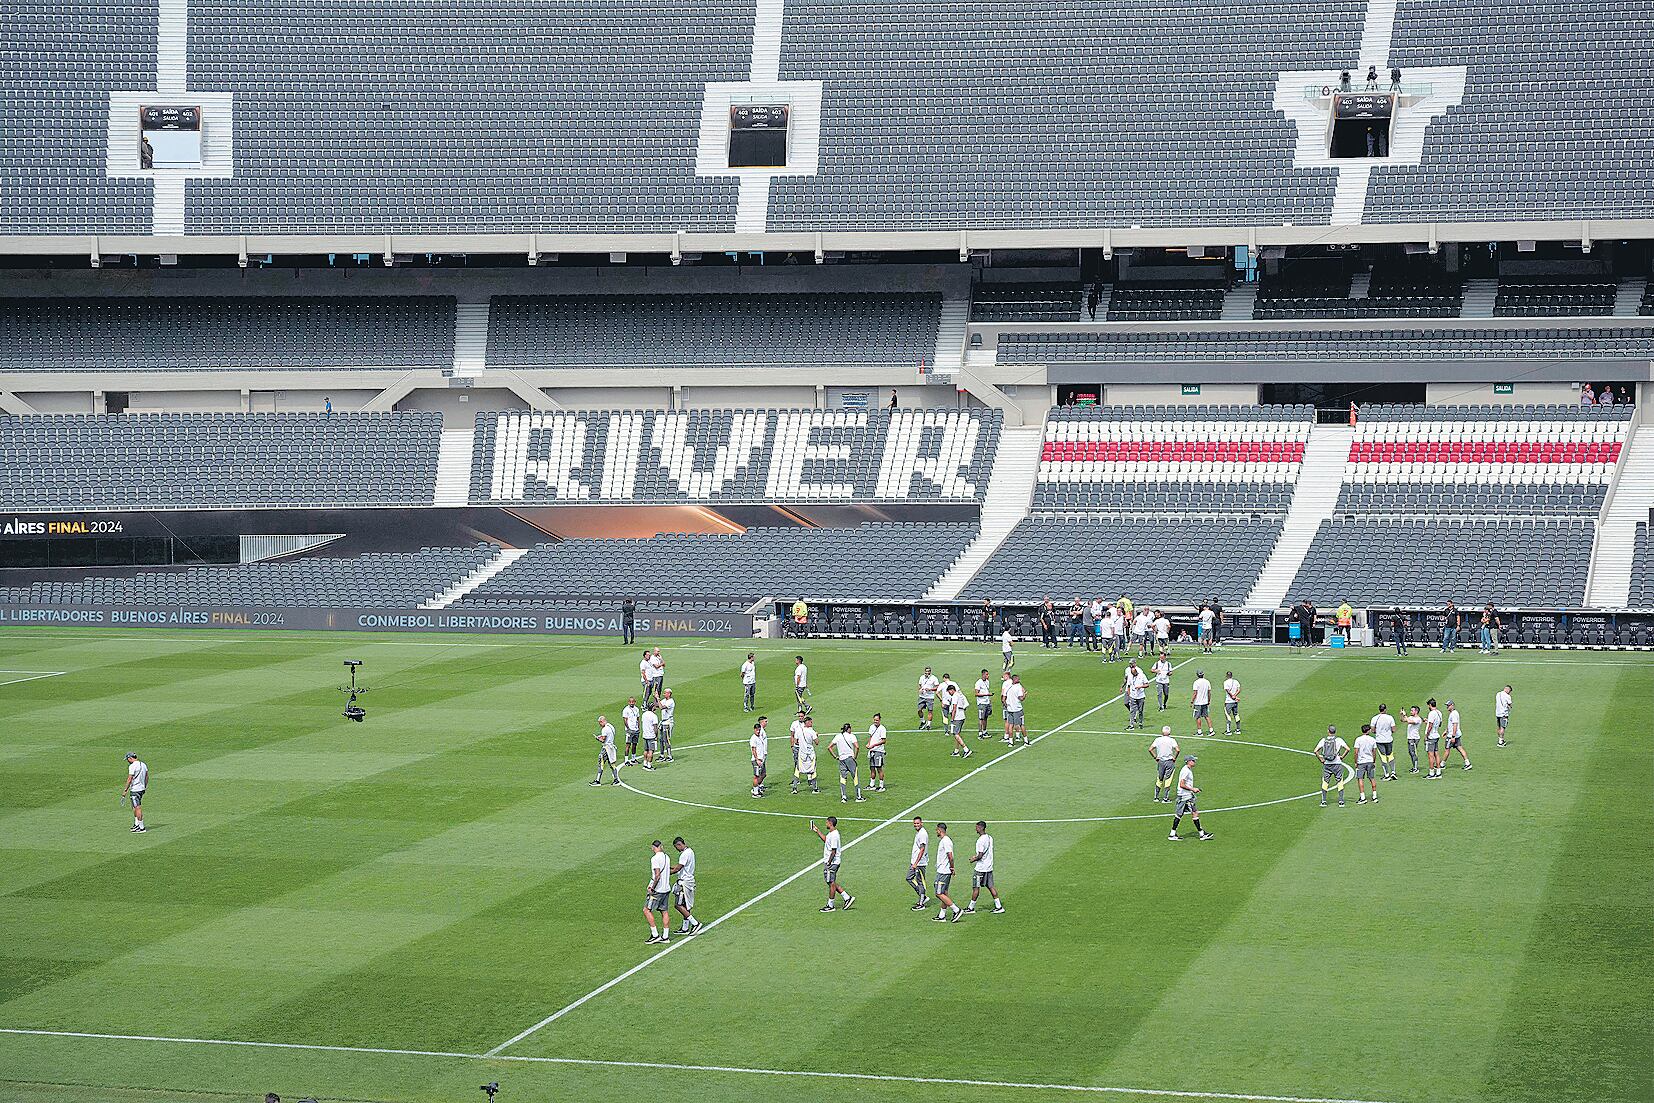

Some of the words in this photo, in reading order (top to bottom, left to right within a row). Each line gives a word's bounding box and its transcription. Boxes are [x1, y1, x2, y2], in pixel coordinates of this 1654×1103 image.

[491, 412, 980, 499] RIVER
[48, 521, 90, 534] FINAL
[90, 520, 124, 533] 2024
[11, 609, 104, 622] LIBERTADORES
[111, 611, 167, 623] BUENOS
[212, 612, 250, 624] FINAL
[252, 612, 285, 625] 2024
[358, 614, 435, 627] CONMEBOL
[438, 616, 537, 629] LIBERTADORES
[545, 617, 605, 630] BUENOS
[607, 612, 651, 631] AIES
[654, 619, 696, 632] FINAL
[698, 619, 733, 633] 2024
